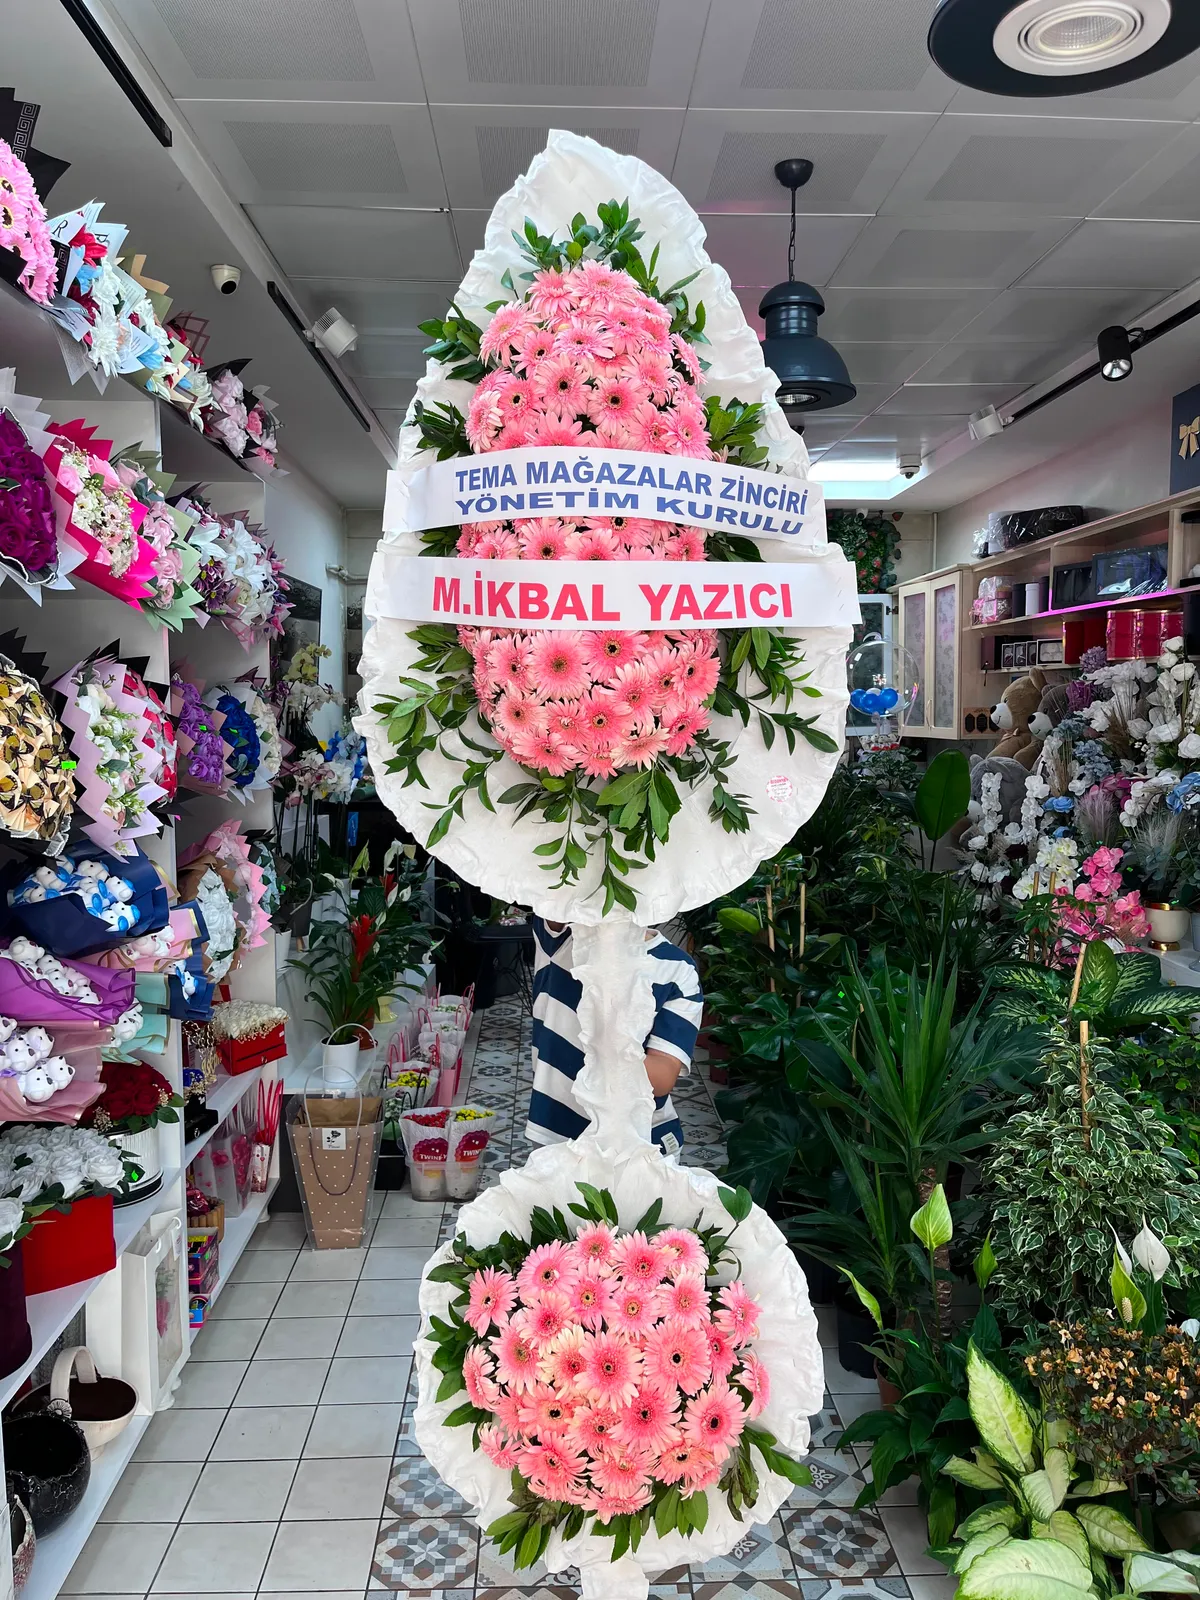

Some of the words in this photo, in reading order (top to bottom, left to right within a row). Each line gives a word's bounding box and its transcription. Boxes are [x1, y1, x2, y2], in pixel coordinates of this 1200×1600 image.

[455, 464, 517, 493] TEMA
[526, 455, 713, 498] MAĞAZALAR
[719, 476, 808, 516] ZİNCİRİ
[455, 487, 639, 515] YÖNETİM
[656, 496, 804, 536] KURULU
[432, 570, 621, 622] M.İKBAL
[639, 583, 793, 621] YAZICI
